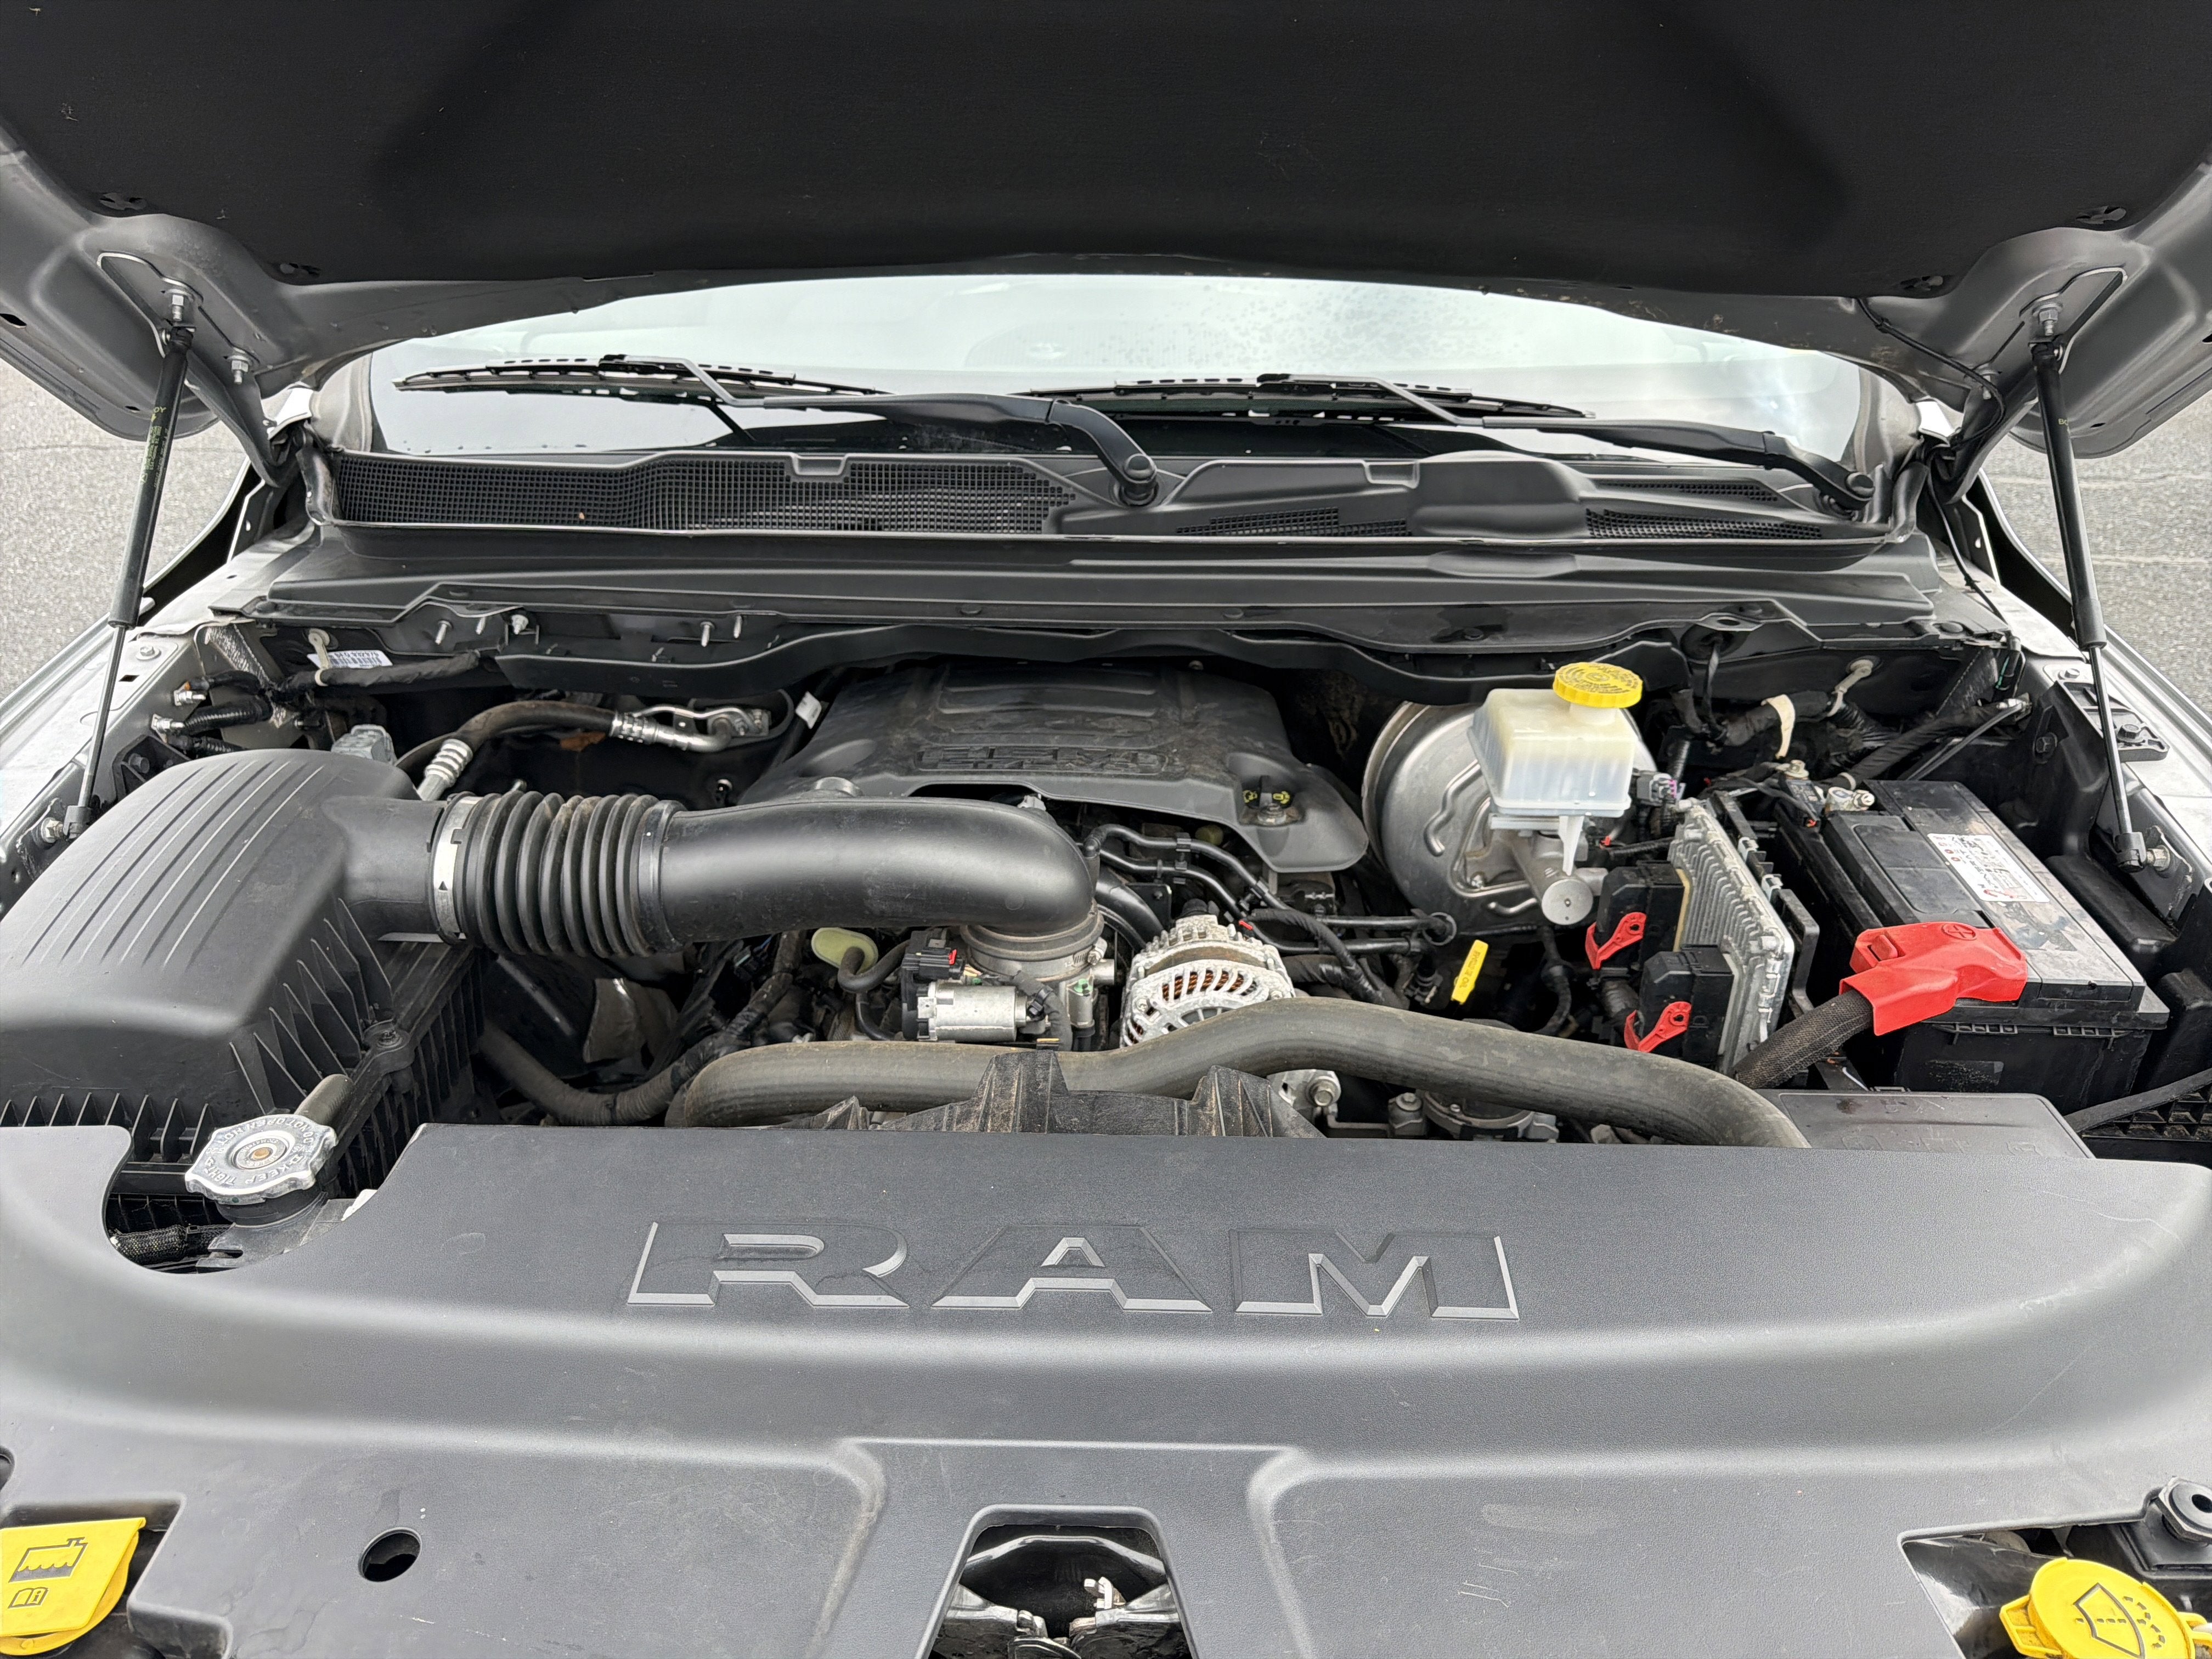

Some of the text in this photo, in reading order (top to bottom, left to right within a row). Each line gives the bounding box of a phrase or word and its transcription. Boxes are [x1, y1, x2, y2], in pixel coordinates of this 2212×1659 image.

[246, 1117, 286, 1130] OPEN
[217, 1126, 244, 1147] HOT
[203, 1163, 290, 1186] KEEP TIGHT
[627, 1219, 1520, 1321] RAM
